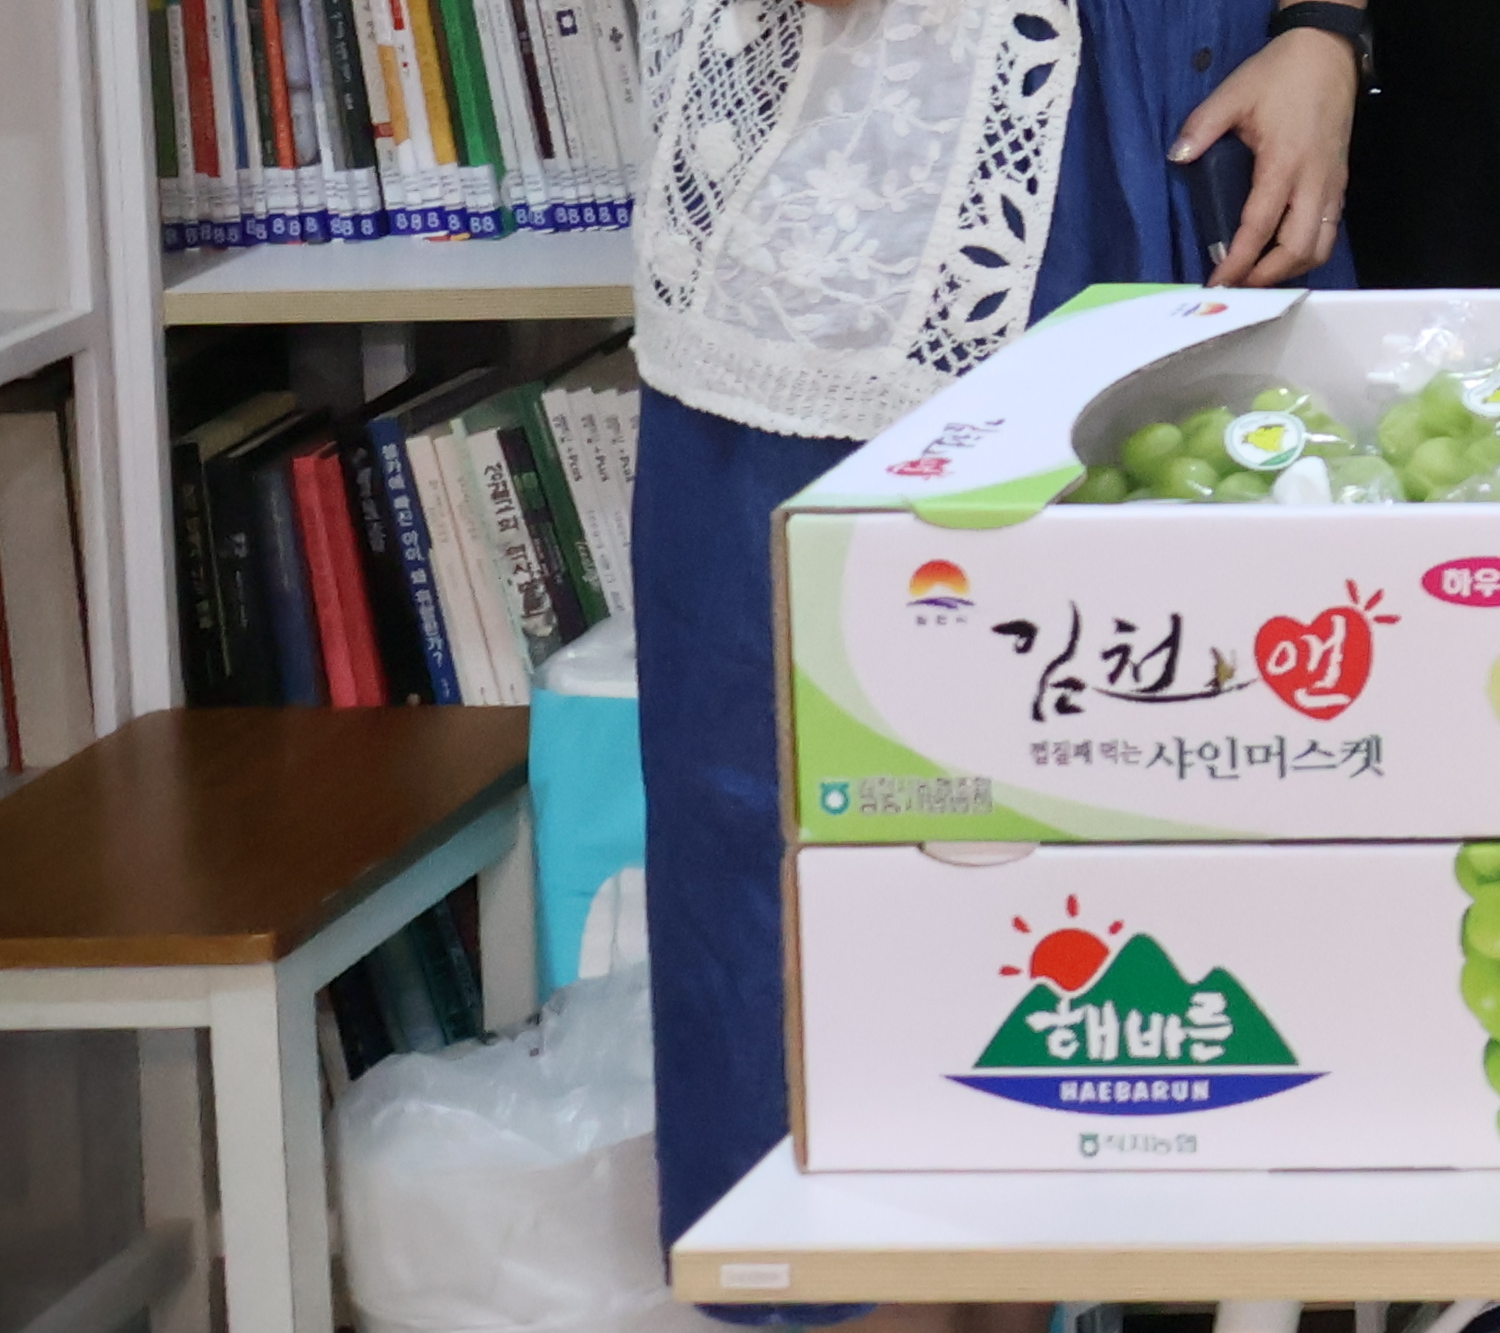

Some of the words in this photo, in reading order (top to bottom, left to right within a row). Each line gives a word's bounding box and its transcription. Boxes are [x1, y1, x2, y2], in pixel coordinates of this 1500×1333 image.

[990, 599, 1188, 723] 김천
[1266, 612, 1353, 710] 앤
[1100, 739, 1144, 766] 먹는
[1146, 733, 1385, 780] 샤인머스켓
[1025, 991, 1234, 1063] 해바른
[1059, 1079, 1211, 1103] HAEBARUN
